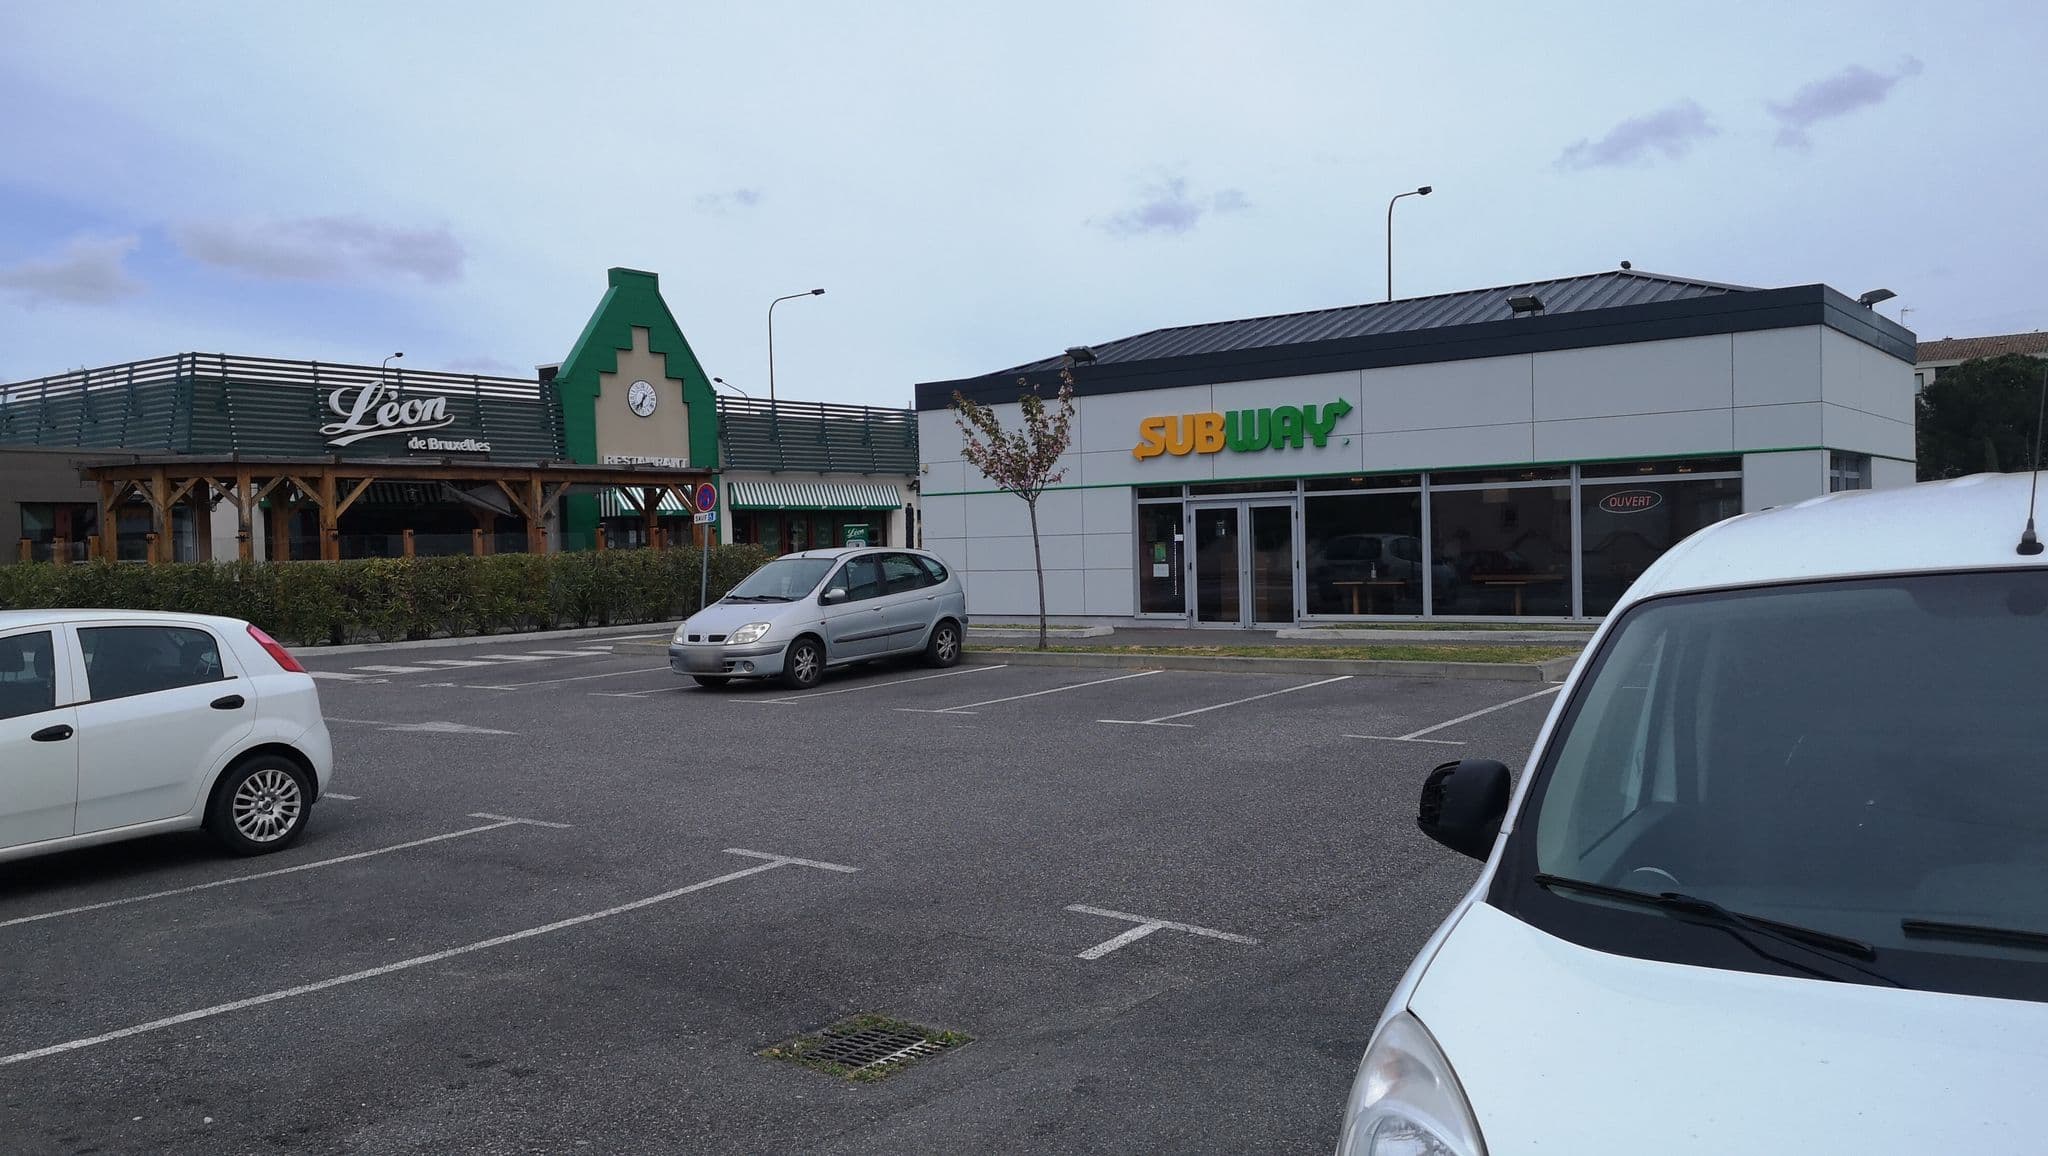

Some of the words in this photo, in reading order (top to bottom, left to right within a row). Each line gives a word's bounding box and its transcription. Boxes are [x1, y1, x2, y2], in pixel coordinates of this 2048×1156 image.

[319, 380, 455, 446] Léon
[1132, 397, 1353, 461] SUBWAY
[408, 436, 427, 450] de
[428, 437, 491, 452] Bruxelles
[1610, 496, 1651, 507] OUVERT
